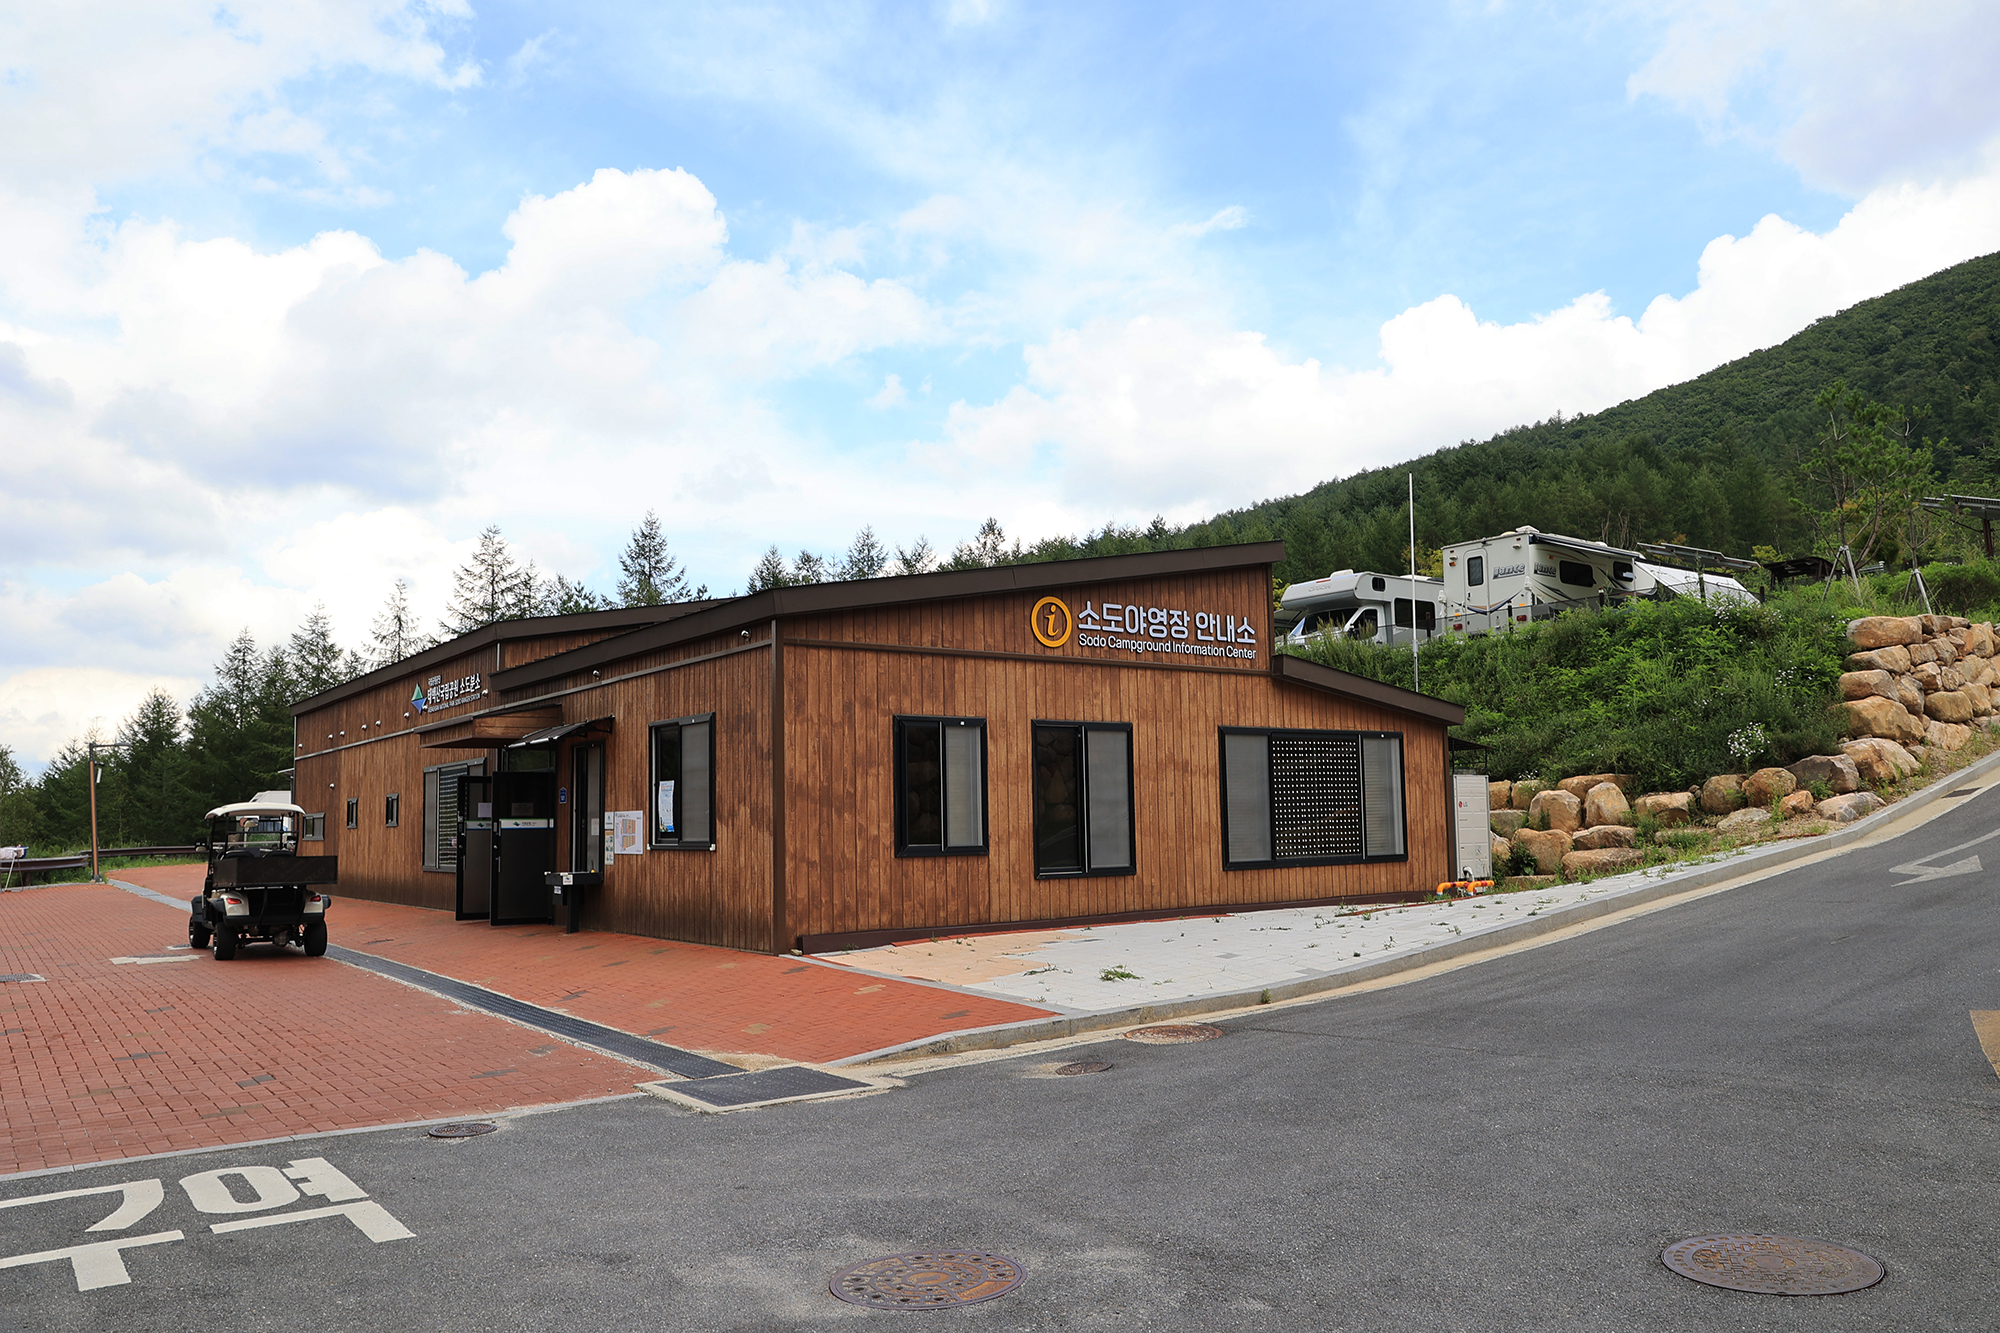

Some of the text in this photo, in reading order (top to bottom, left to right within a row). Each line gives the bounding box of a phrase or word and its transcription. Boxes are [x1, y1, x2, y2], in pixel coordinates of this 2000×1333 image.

[1078, 600, 1256, 643] 소도야영장 안내소
[1079, 633, 1257, 659] Sodo Campground Information Center
[460, 673, 481, 694] 소도분소
[0, 1157, 416, 1291] 구역
